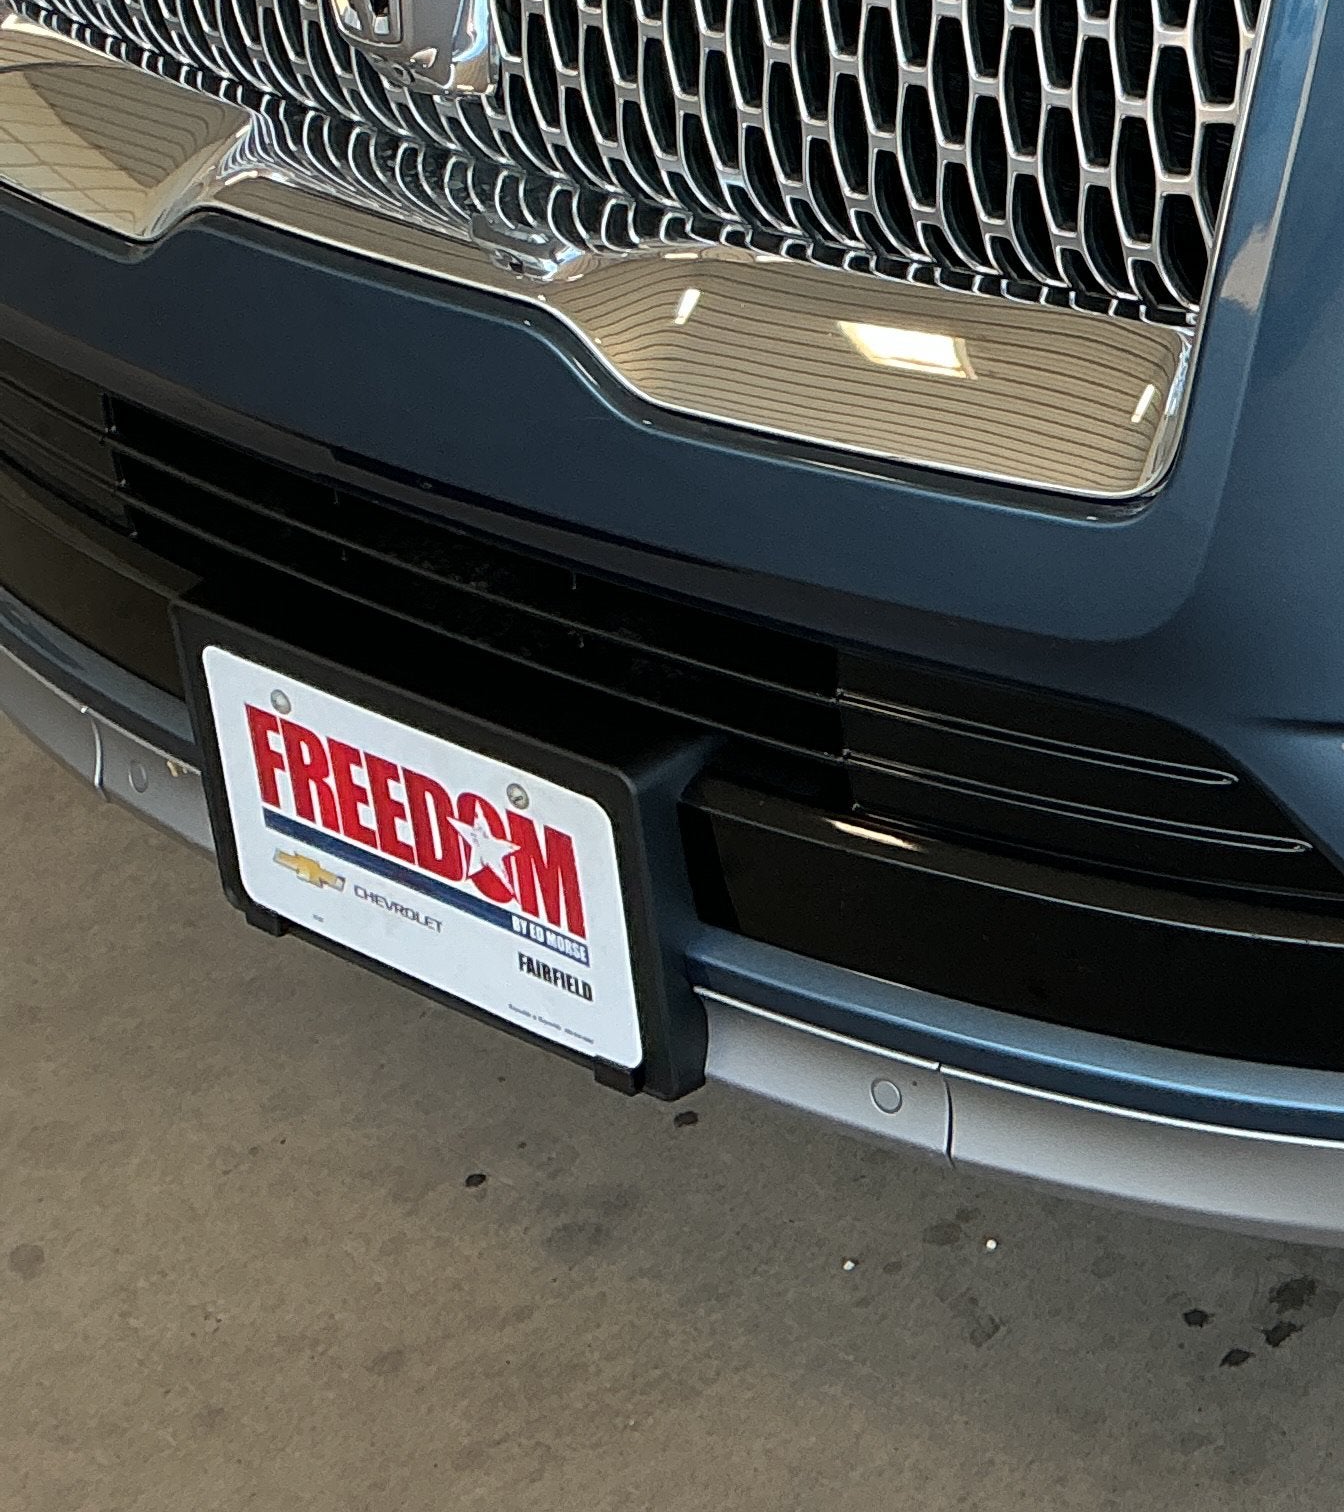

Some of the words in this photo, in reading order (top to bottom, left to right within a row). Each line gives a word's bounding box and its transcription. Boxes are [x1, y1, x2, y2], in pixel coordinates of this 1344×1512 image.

[243, 701, 586, 939] FREEDOM
[353, 884, 443, 934] CHEVROLET
[511, 914, 528, 935] BY
[529, 923, 545, 943] ED
[545, 930, 588, 963] MORSE
[517, 950, 594, 1002] FAIRFIELD
